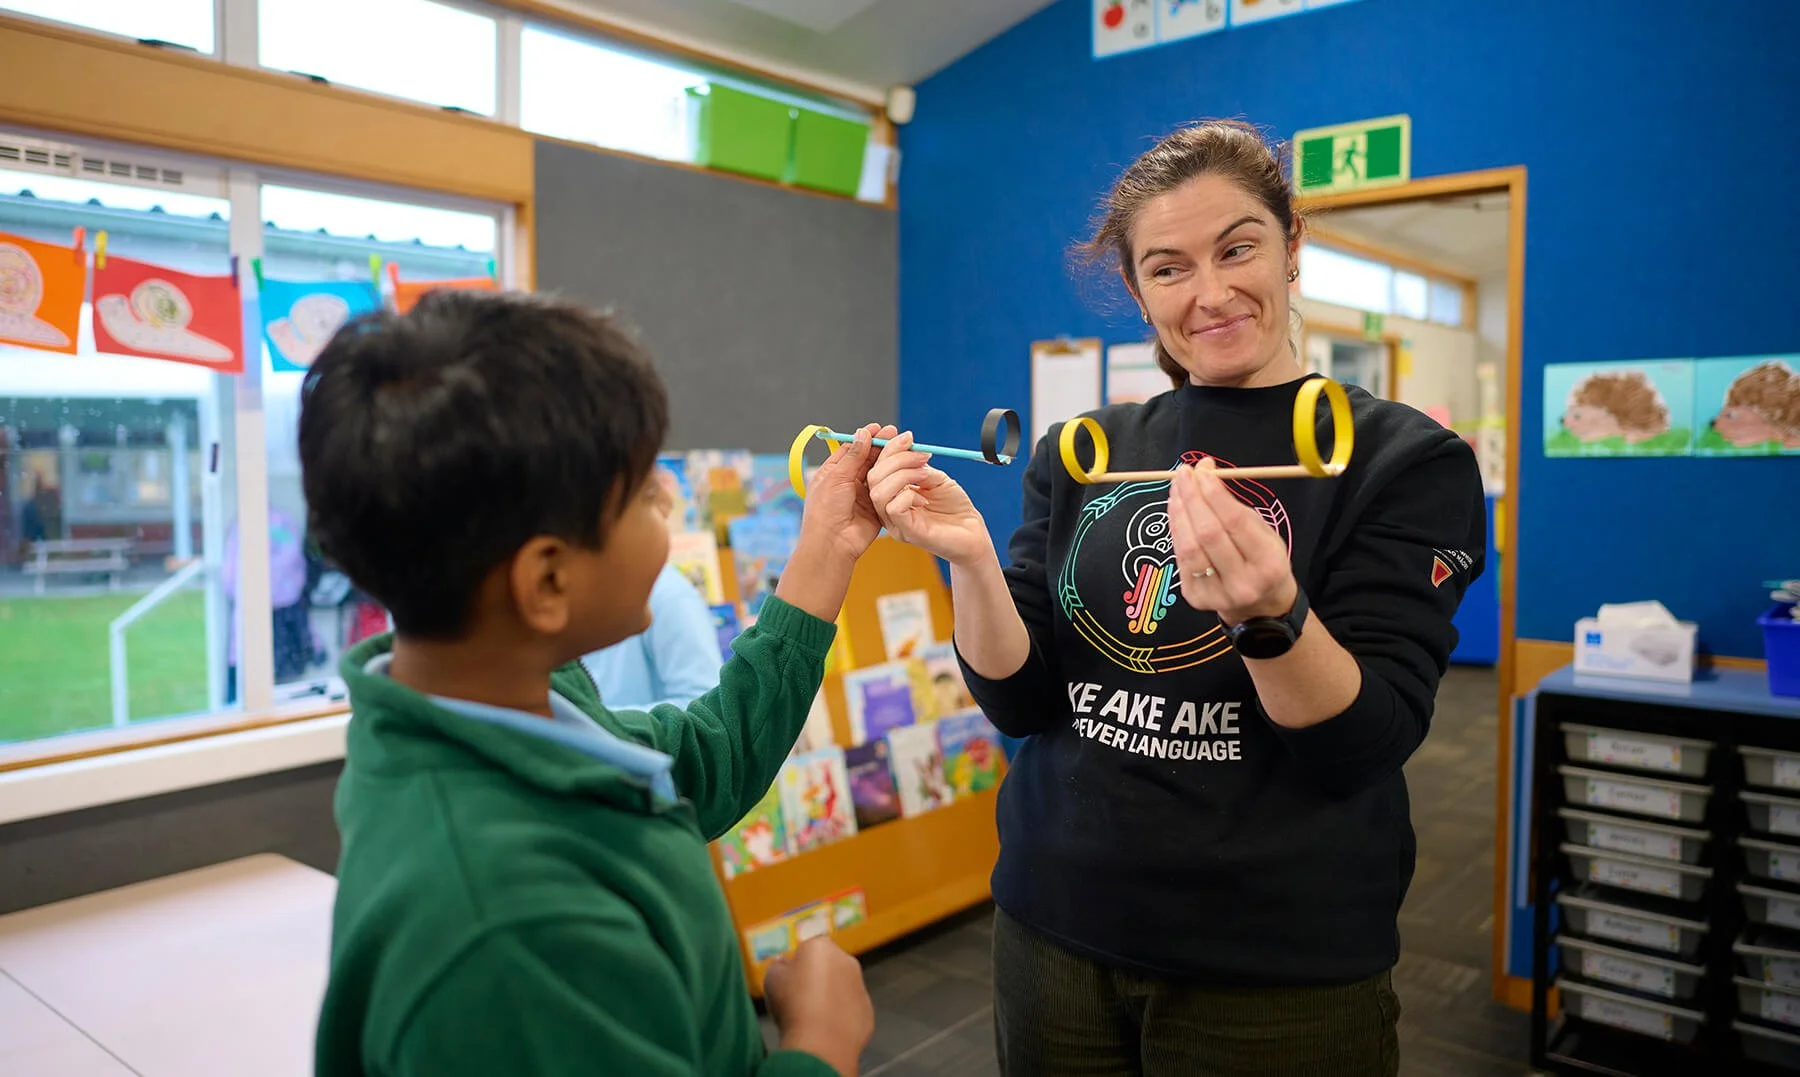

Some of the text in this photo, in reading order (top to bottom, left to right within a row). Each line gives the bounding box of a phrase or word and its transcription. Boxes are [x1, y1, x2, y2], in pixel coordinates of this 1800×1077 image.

[1099, 689, 1166, 731] AKE
[1170, 701, 1241, 735] AKE
[1128, 733, 1242, 761] LANGUAGE
